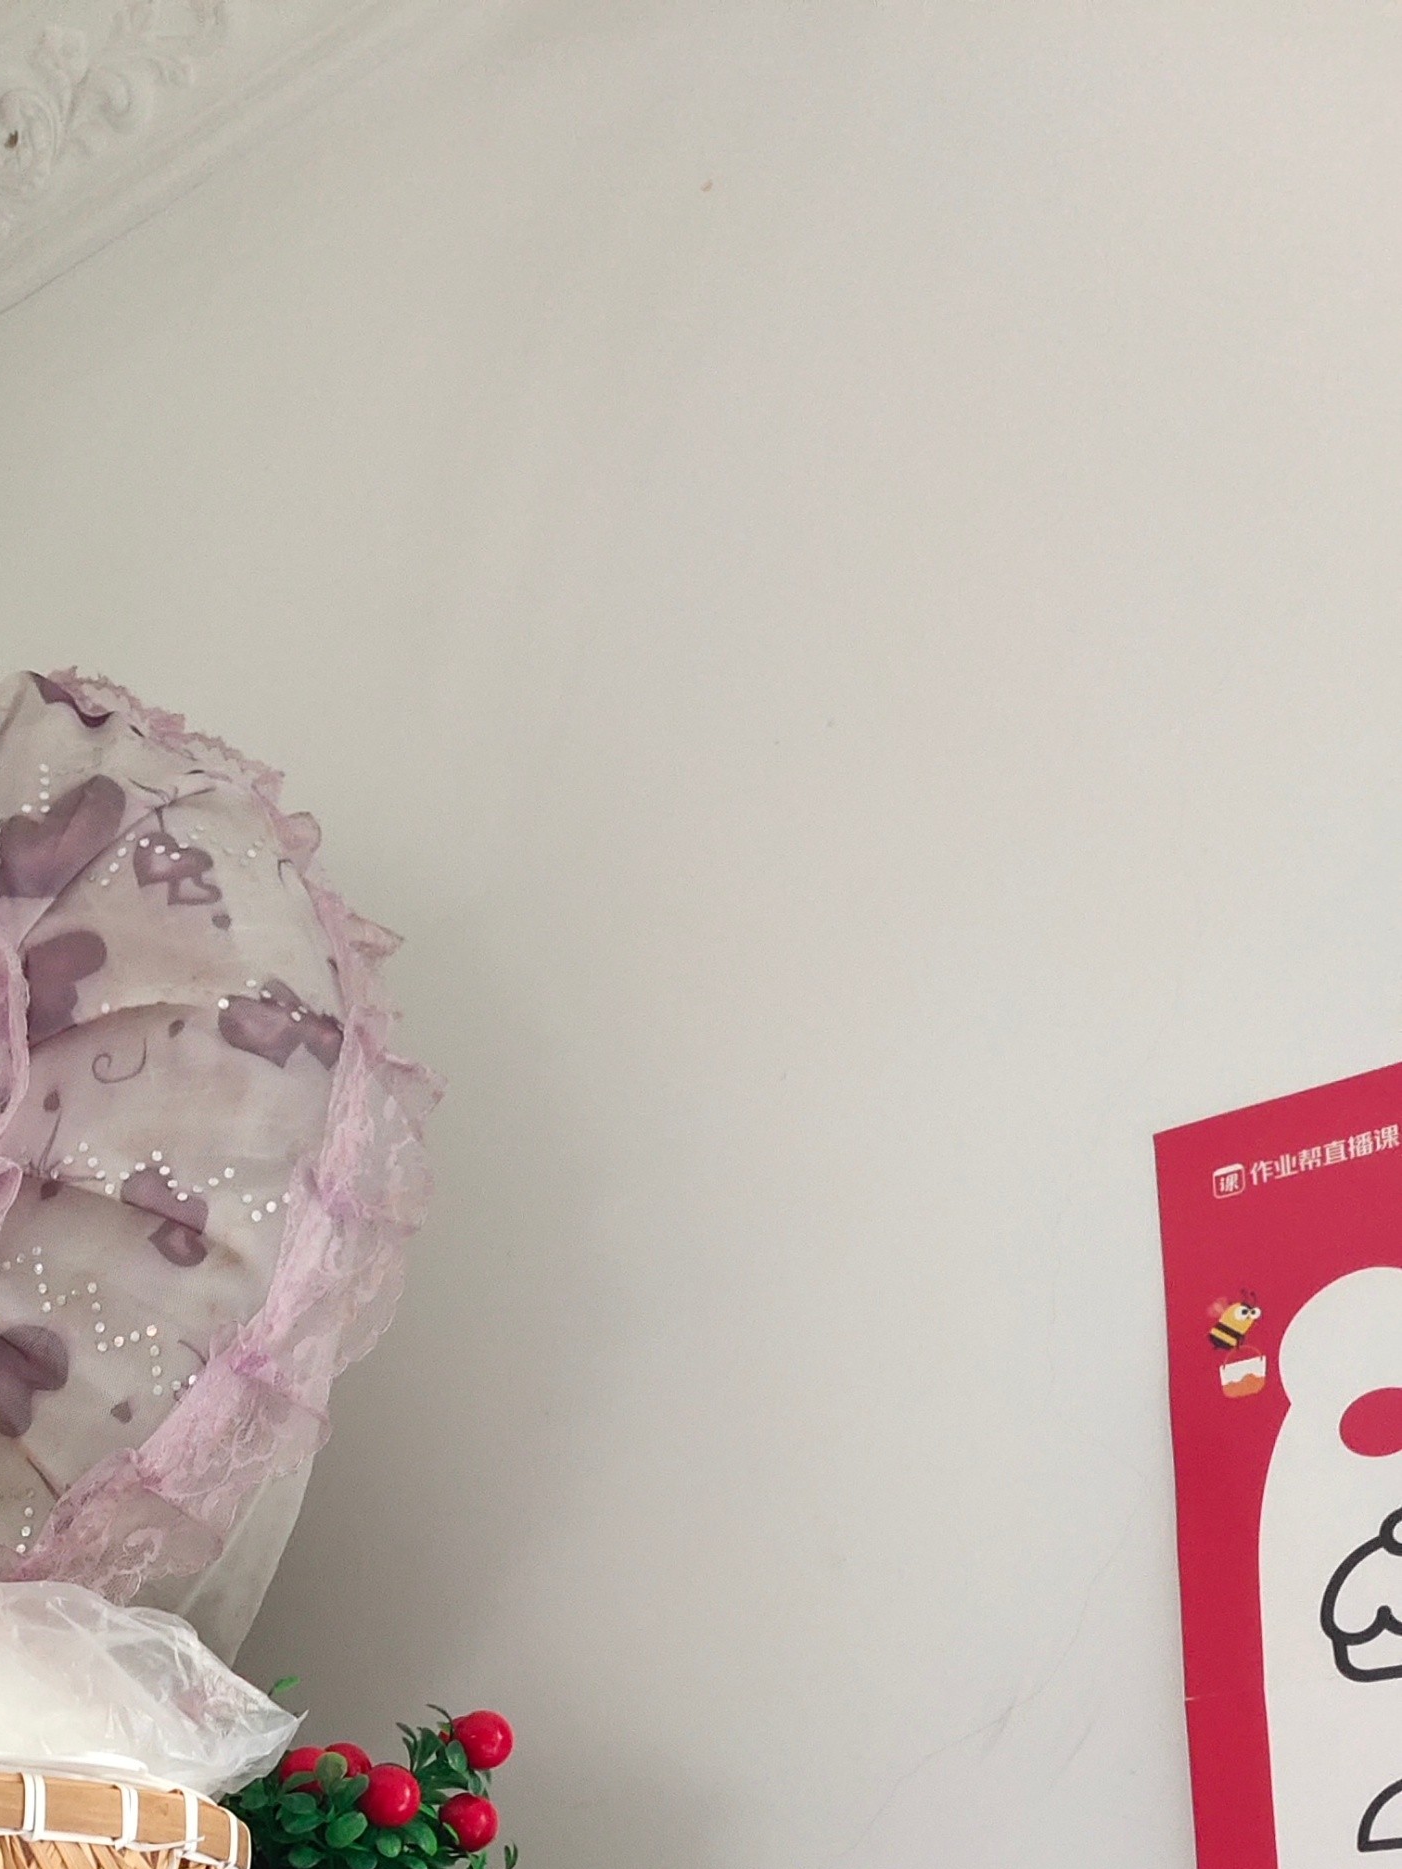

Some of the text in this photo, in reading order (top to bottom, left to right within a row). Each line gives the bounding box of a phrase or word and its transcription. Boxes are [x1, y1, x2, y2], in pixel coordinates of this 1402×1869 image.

[1219, 1123, 1401, 1193] 课 作业帮直播课
